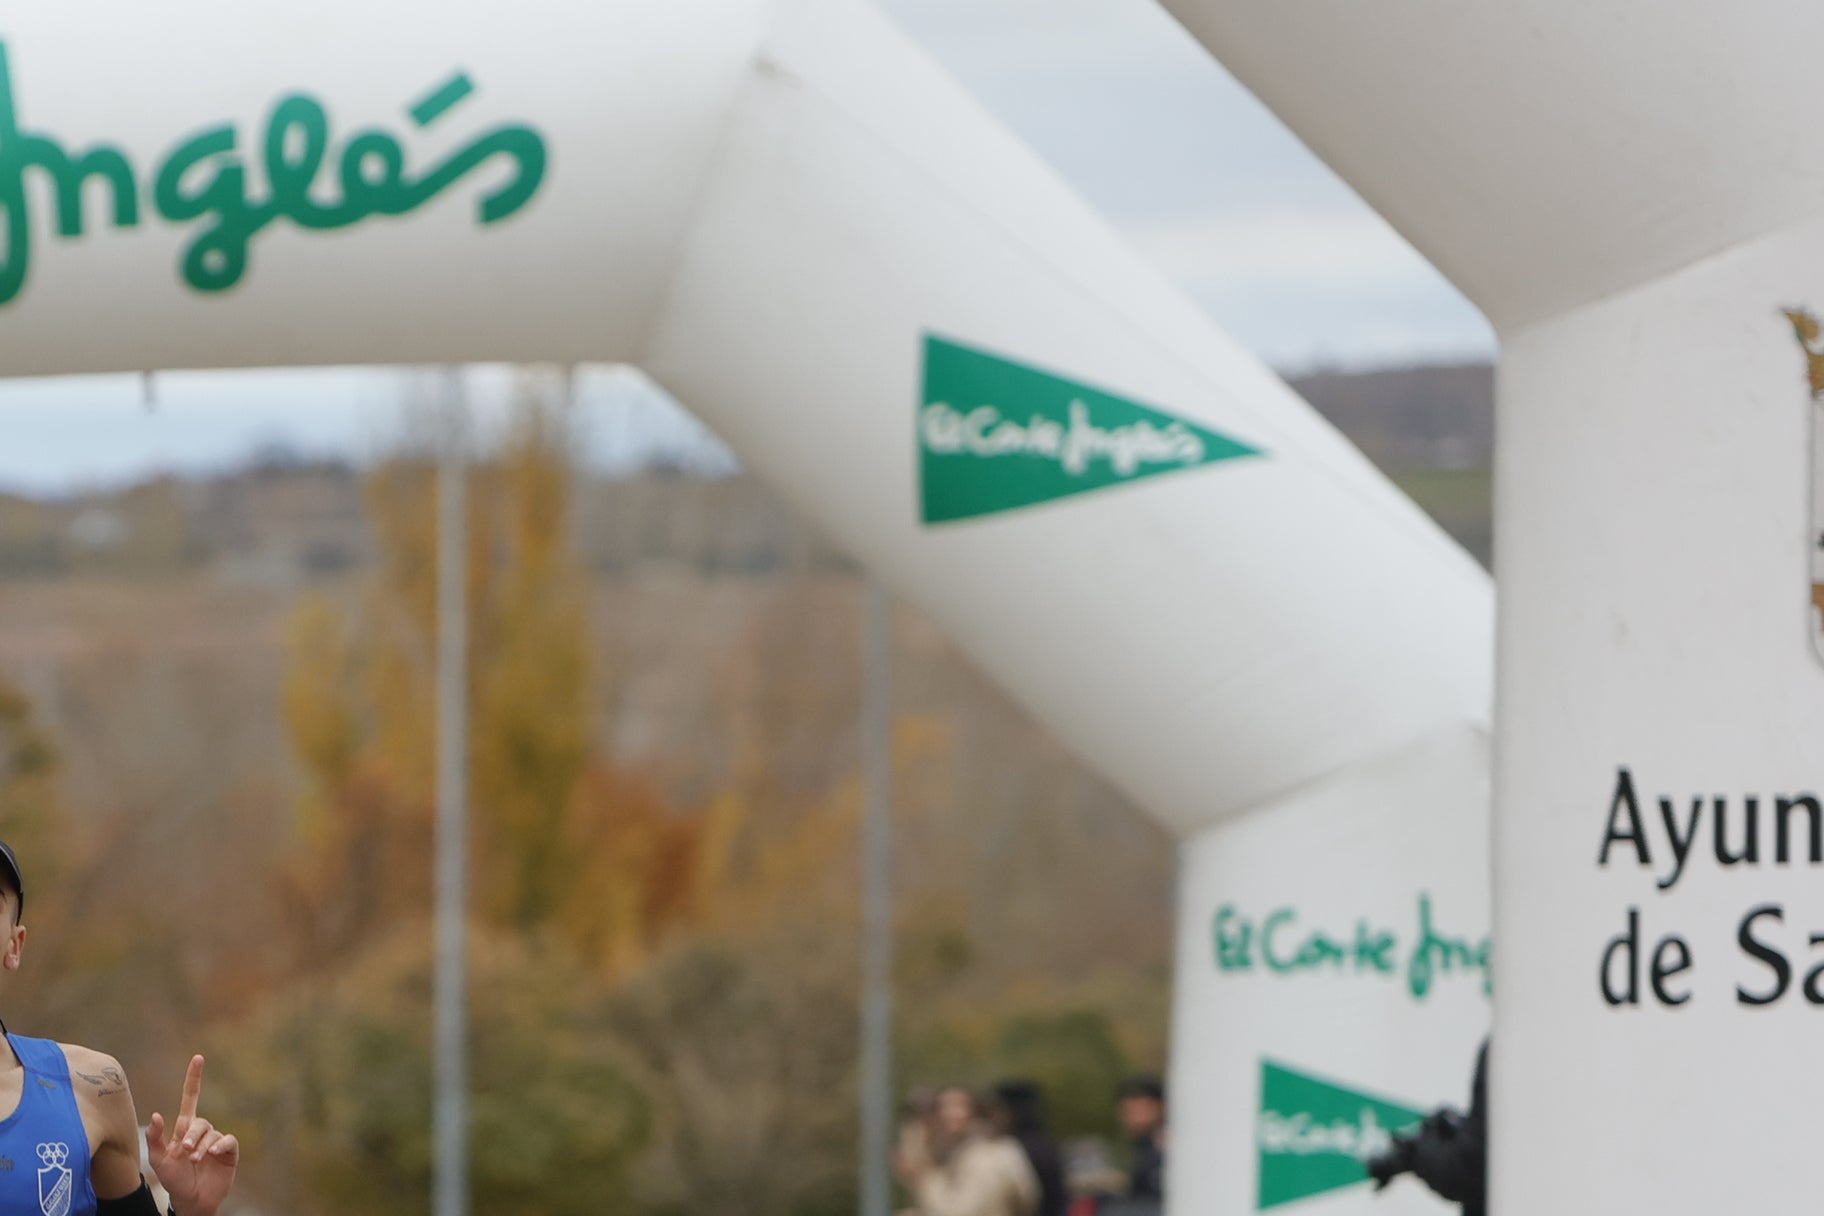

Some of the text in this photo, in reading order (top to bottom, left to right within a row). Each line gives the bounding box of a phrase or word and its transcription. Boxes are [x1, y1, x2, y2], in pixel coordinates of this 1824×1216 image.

[1212, 903, 1253, 972] El
[1260, 902, 1398, 974] Corte
[1599, 905, 1693, 1006] de
